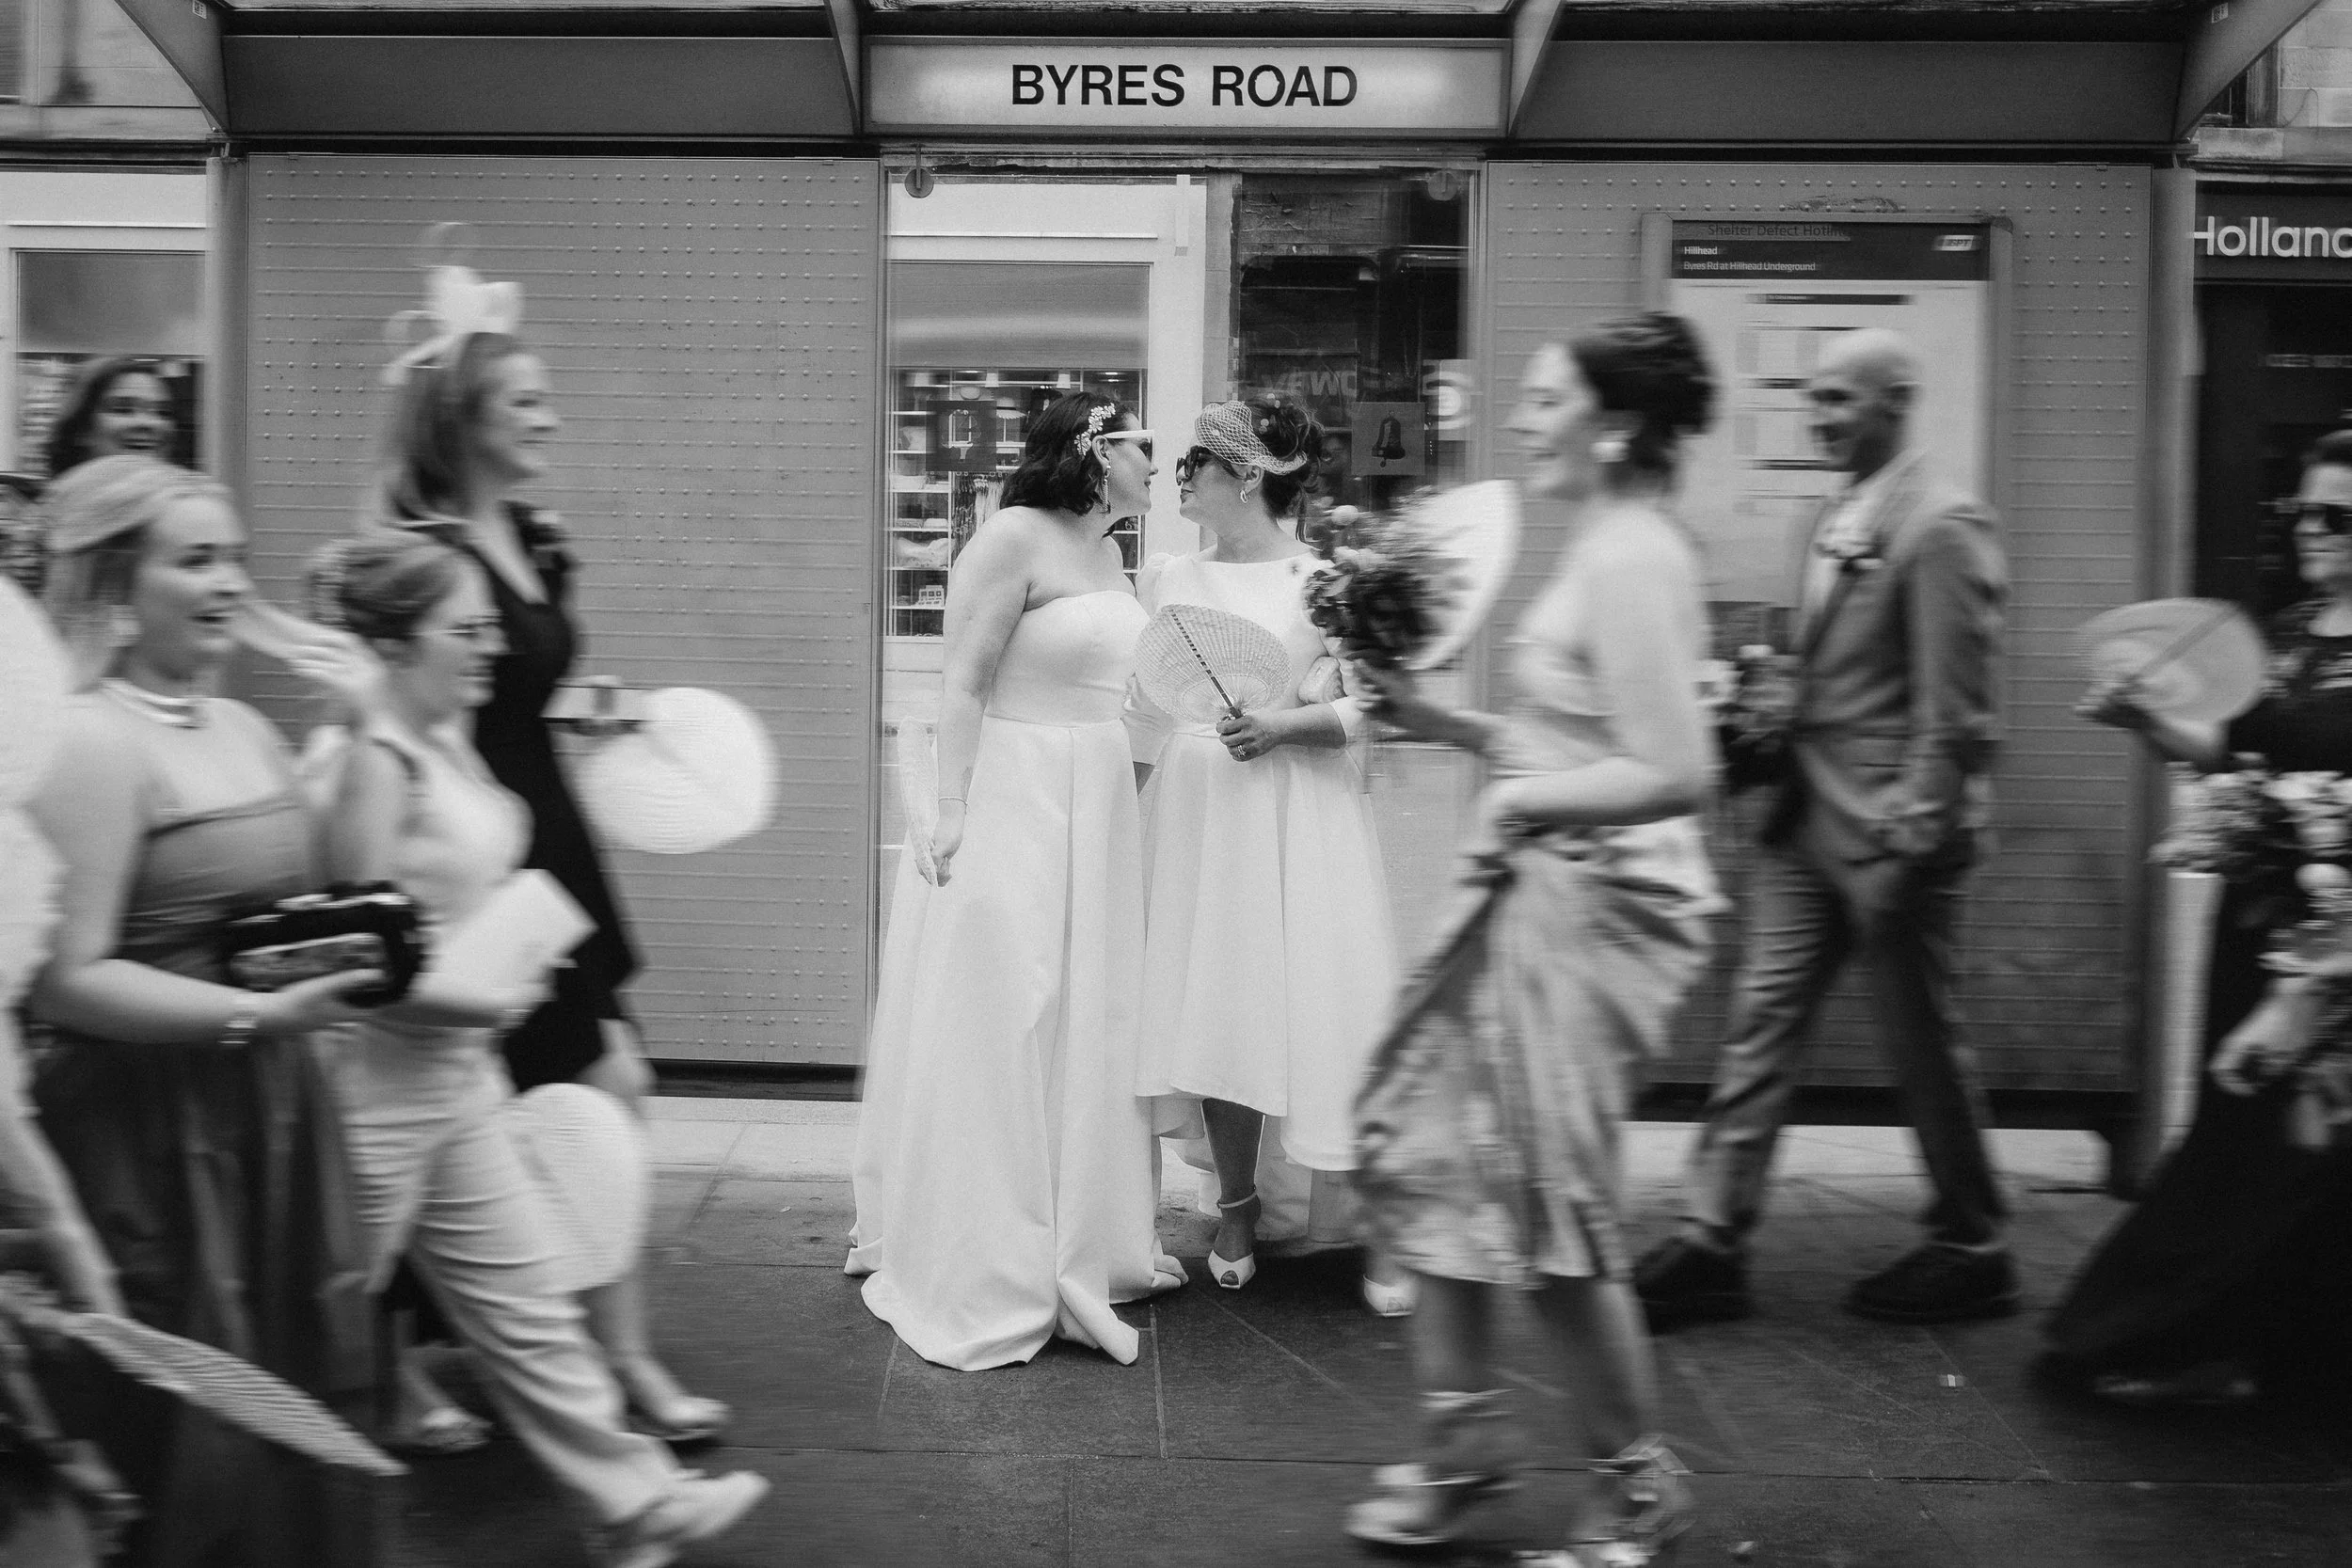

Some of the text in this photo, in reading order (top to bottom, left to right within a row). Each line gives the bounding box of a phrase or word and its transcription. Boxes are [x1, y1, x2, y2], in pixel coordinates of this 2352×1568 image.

[1012, 64, 1358, 107] BYRES ROAD
[1708, 223, 1753, 236] Shelter
[1756, 224, 1800, 237] Defect
[1684, 245, 1718, 255] Hillhead
[1683, 261, 1706, 271] Byres
[1707, 261, 1719, 270] Rd
[1729, 261, 1762, 271] Hillhead
[1763, 262, 1816, 273] Underground
